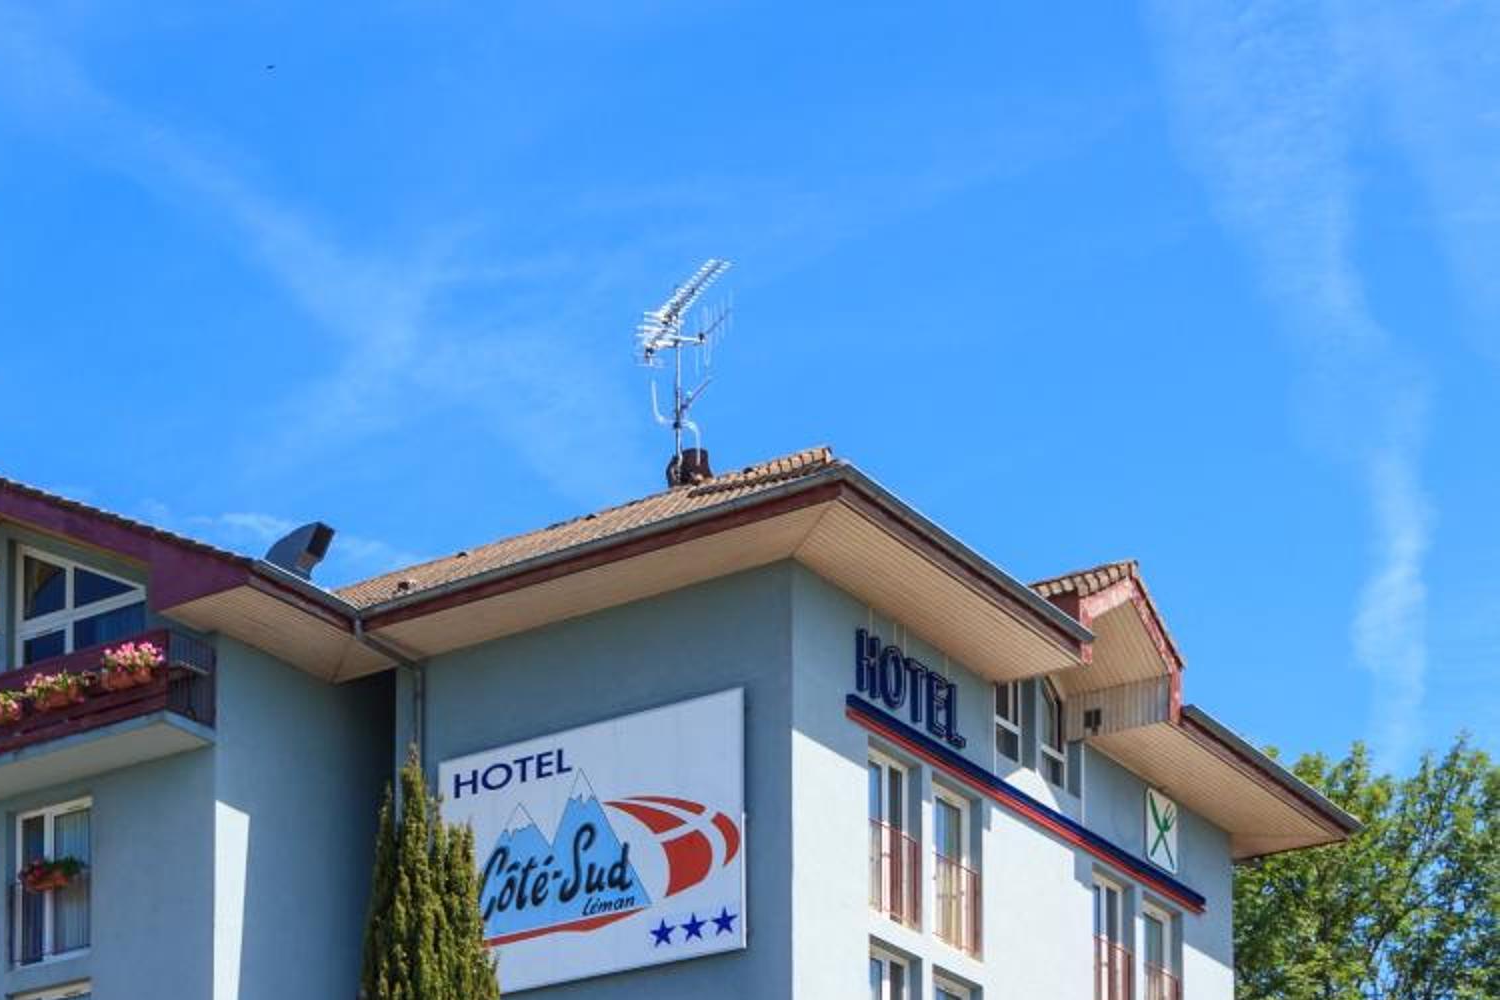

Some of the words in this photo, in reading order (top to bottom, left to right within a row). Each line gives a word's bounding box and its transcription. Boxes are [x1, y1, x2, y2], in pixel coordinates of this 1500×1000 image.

[855, 628, 966, 748] HOTEL
[453, 748, 572, 799] HOTEL
[478, 823, 633, 921] Côté-Sud
